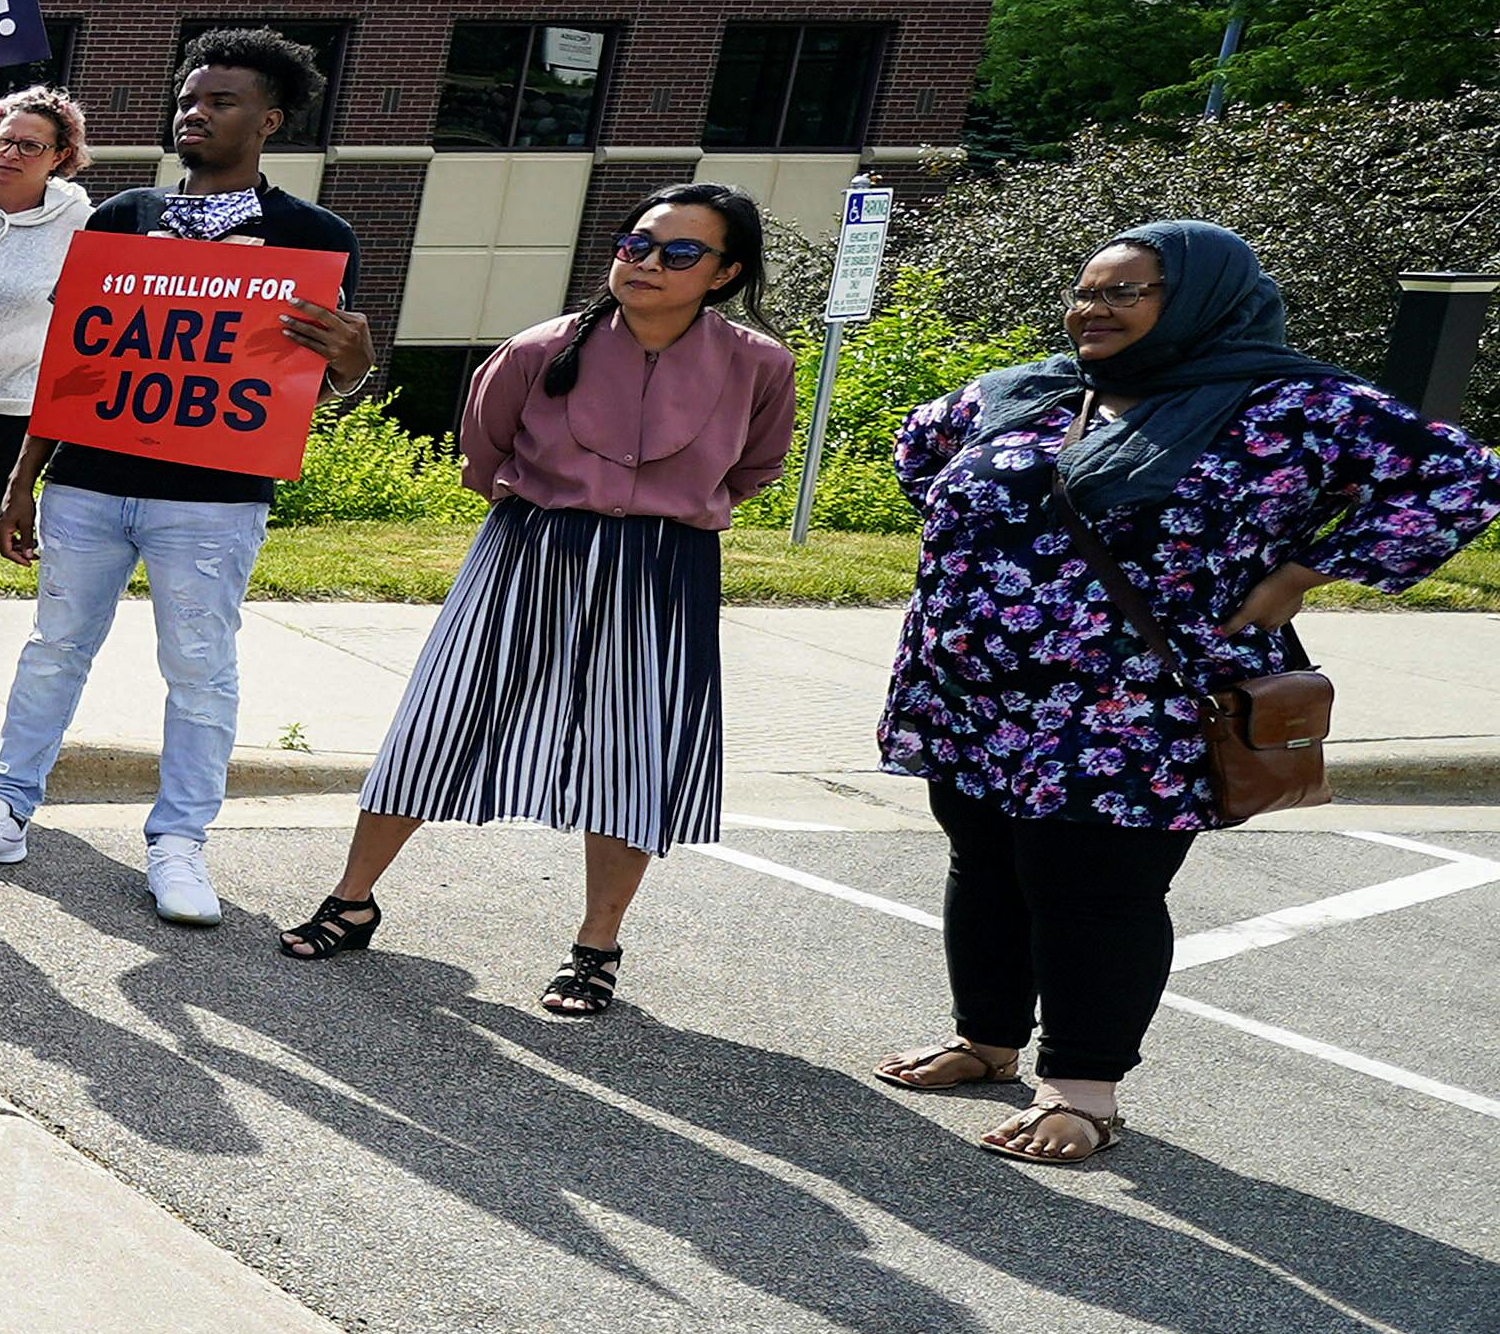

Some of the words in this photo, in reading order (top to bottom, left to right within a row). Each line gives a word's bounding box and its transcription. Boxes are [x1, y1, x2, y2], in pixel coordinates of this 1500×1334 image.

[103, 275, 135, 294] $10
[144, 275, 241, 297] TRILLION
[247, 279, 298, 303] FOR
[74, 306, 242, 363] CARE
[96, 371, 271, 431] JOBS
